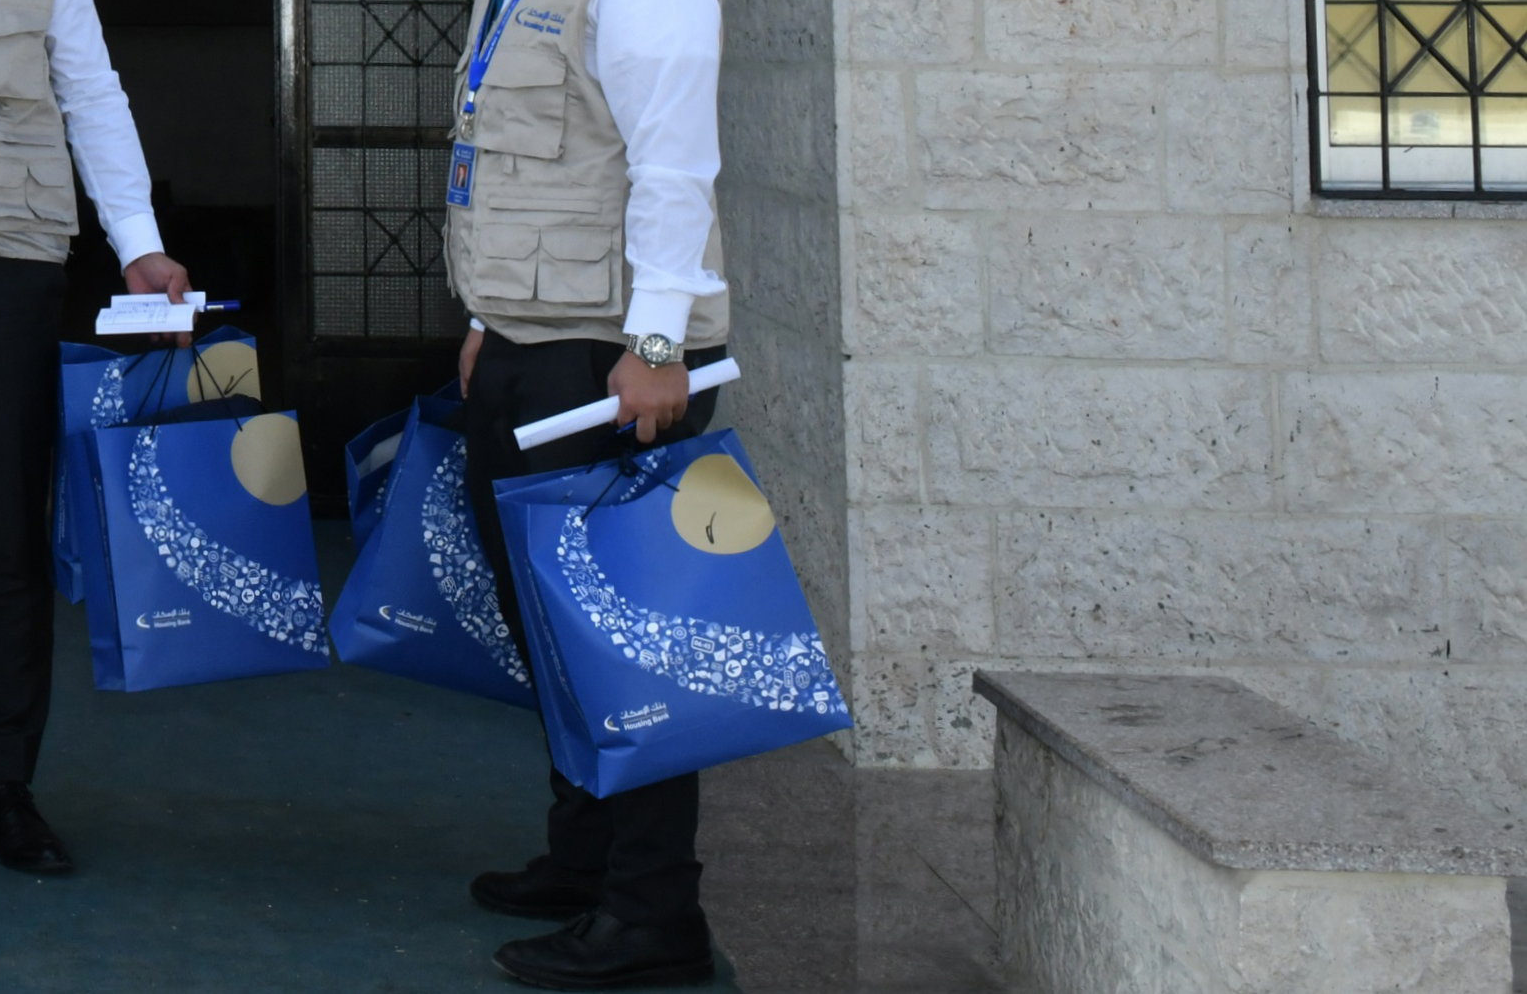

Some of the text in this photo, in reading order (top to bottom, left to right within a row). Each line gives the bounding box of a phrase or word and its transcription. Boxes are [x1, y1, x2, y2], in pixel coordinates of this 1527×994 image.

[419, 625, 433, 634] Bank
[623, 712, 670, 731] Housing Bank
